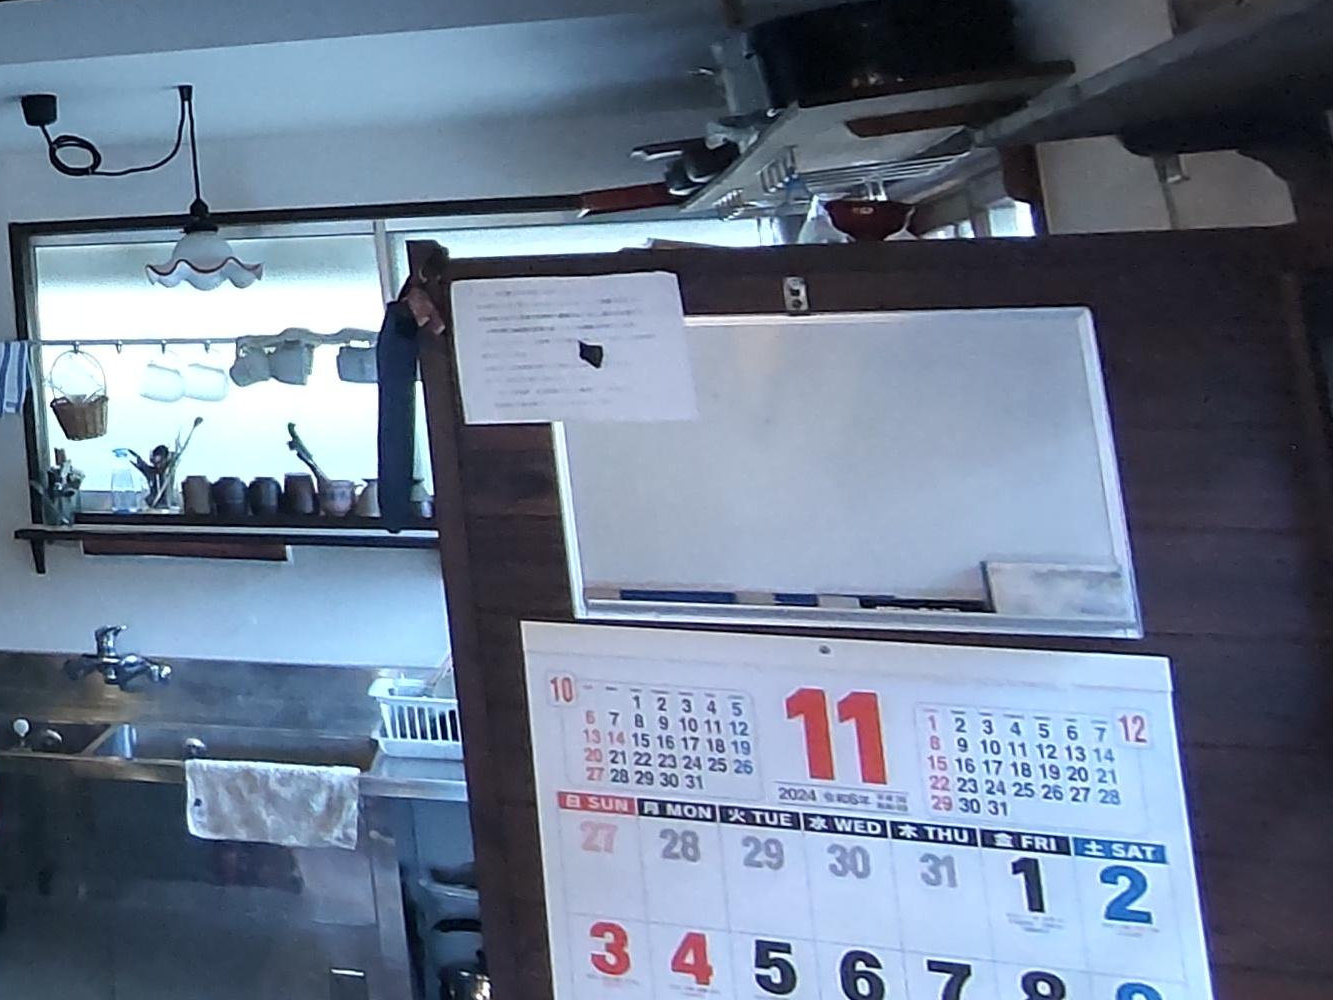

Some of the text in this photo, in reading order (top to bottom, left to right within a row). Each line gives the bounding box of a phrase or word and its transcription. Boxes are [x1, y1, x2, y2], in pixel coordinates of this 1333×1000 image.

[550, 677, 574, 702] 10
[633, 696, 742, 716] 1 2 3 4 5
[586, 711, 748, 736] 6 7 8 9 10 11 12
[786, 688, 887, 785] 11
[929, 715, 1106, 742] 1 2 3 4 5 6 7
[1119, 715, 1147, 743] 12
[584, 729, 751, 755] 13 14 15 16 17 18 19
[930, 736, 1115, 763] 8 9 10 11 12 13 14
[585, 748, 753, 774] 20 21 22 23 24 25 26
[927, 755, 1116, 784] 15 16 17 18 19 20 21
[586, 767, 703, 789] 27 28 29 30 31
[930, 775, 1121, 805] 22 23 24 25 26 27 28
[778, 787, 816, 801] 2024
[932, 795, 1007, 816] 29 30 31
[565, 795, 1156, 860] 日 SUN 月 MON 火 TUE 水 WED 木 THU 金 FRI 土 SAT
[580, 820, 617, 853] 27
[659, 828, 700, 861] 28
[742, 836, 783, 870] 29
[827, 844, 870, 878] 30
[919, 853, 957, 888] 31
[1011, 857, 1046, 913] 1
[1099, 865, 1153, 924] 2
[590, 922, 630, 975] 3
[671, 932, 713, 986] 4
[755, 940, 797, 995] 5
[840, 950, 885, 1000] 6
[927, 959, 972, 1000] 7
